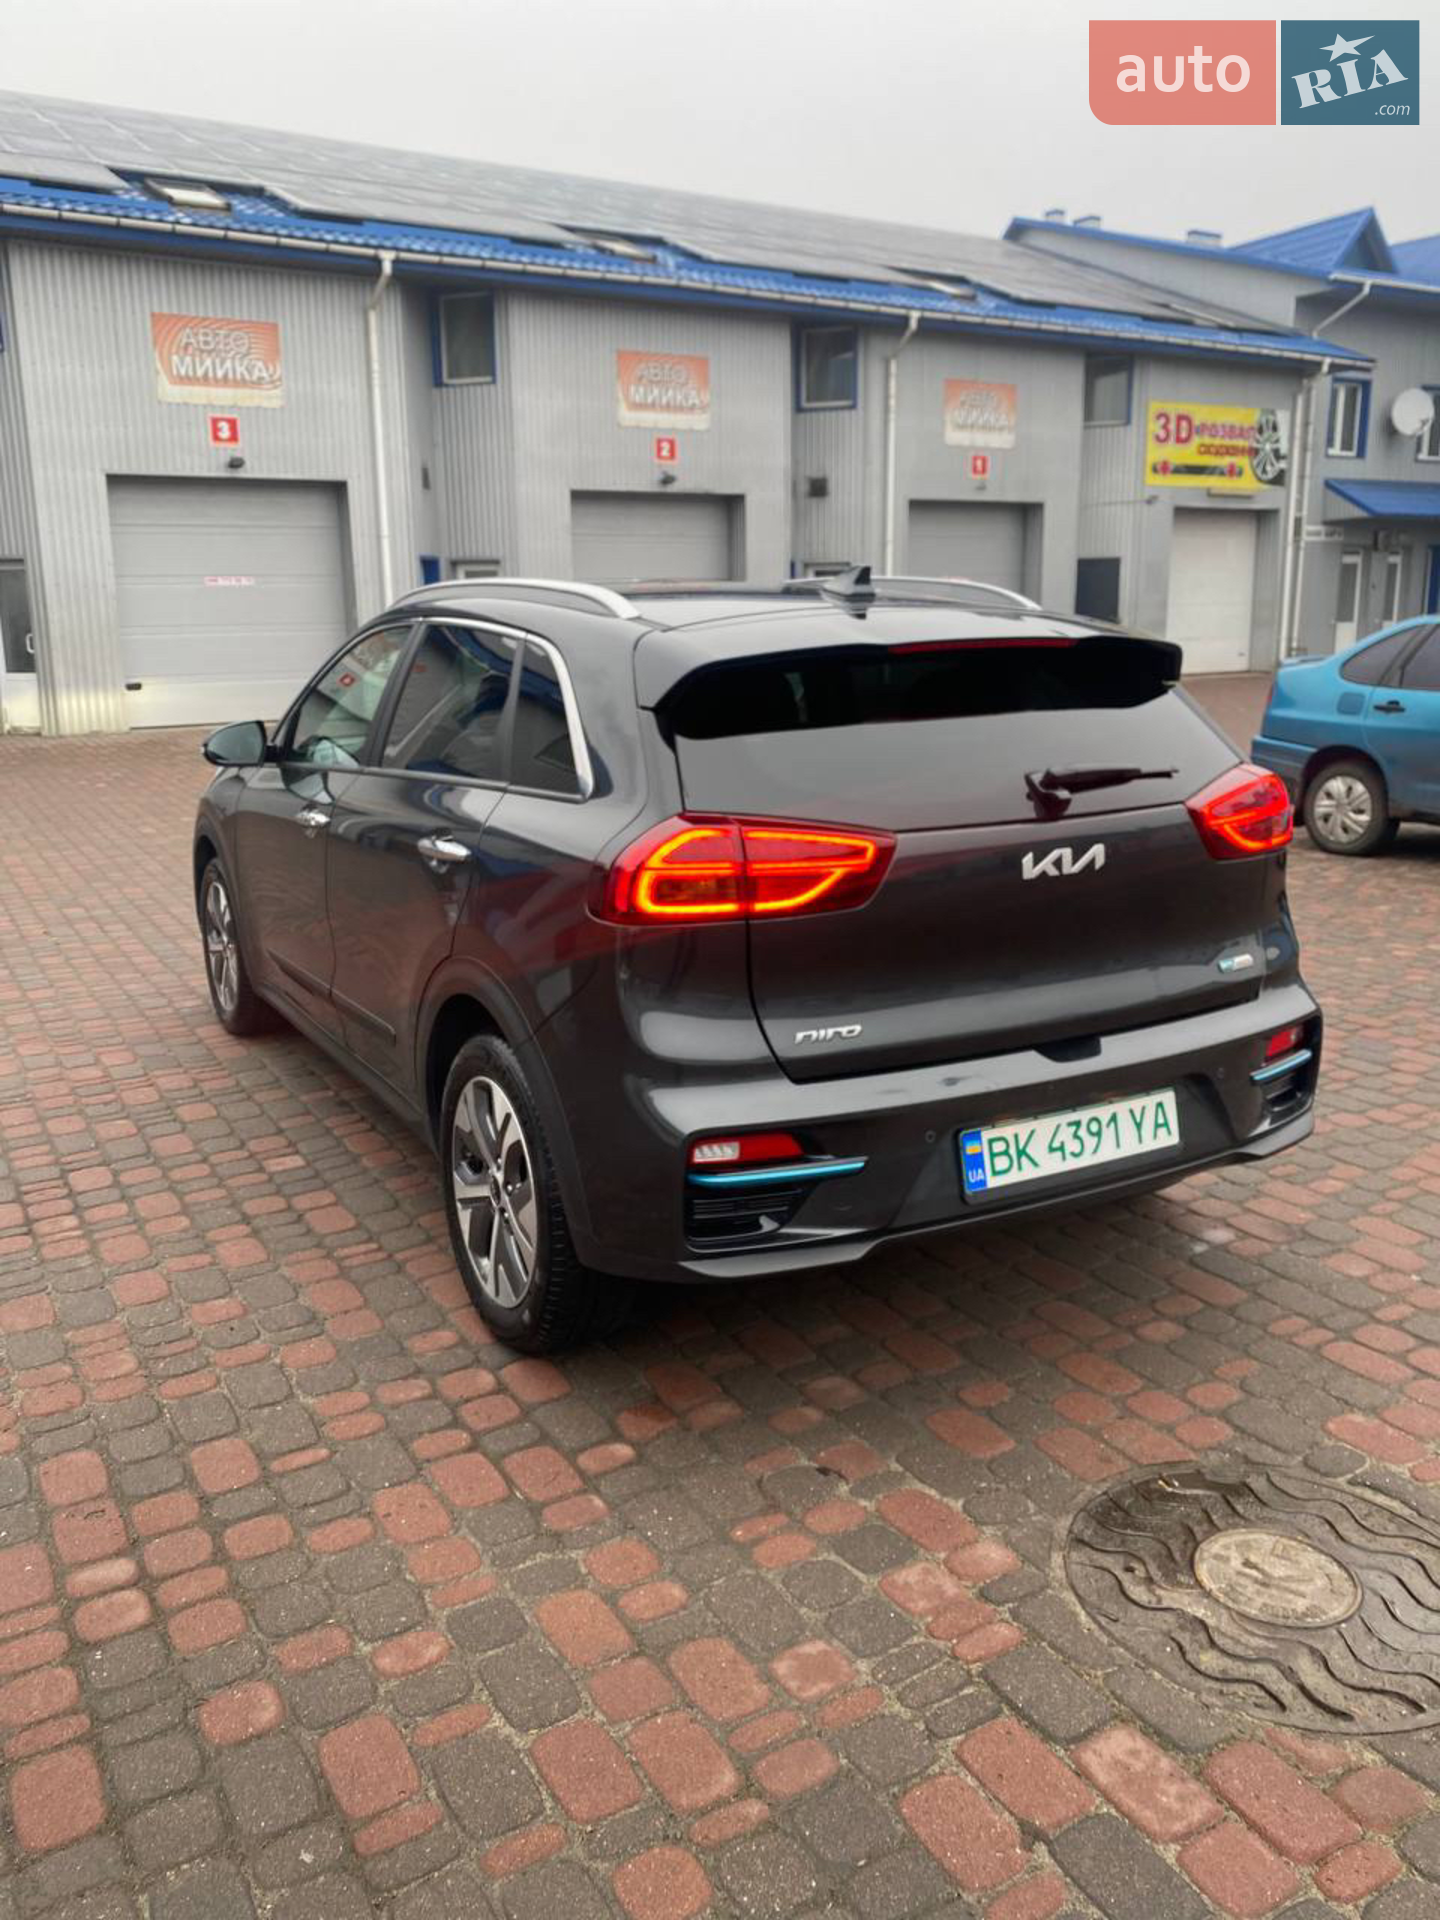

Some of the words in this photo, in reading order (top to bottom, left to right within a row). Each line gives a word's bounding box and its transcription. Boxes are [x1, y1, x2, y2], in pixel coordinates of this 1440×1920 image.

[180, 327, 250, 352] АВТО
[216, 420, 231, 439] 3
[1154, 411, 1194, 445] 3D
[660, 440, 671, 457] 2
[1022, 842, 1105, 880] KIA
[987, 1128, 1040, 1177] BK
[1047, 1111, 1121, 1162] 4391
[1129, 1100, 1172, 1145] YA
[968, 1168, 984, 1183] UA
